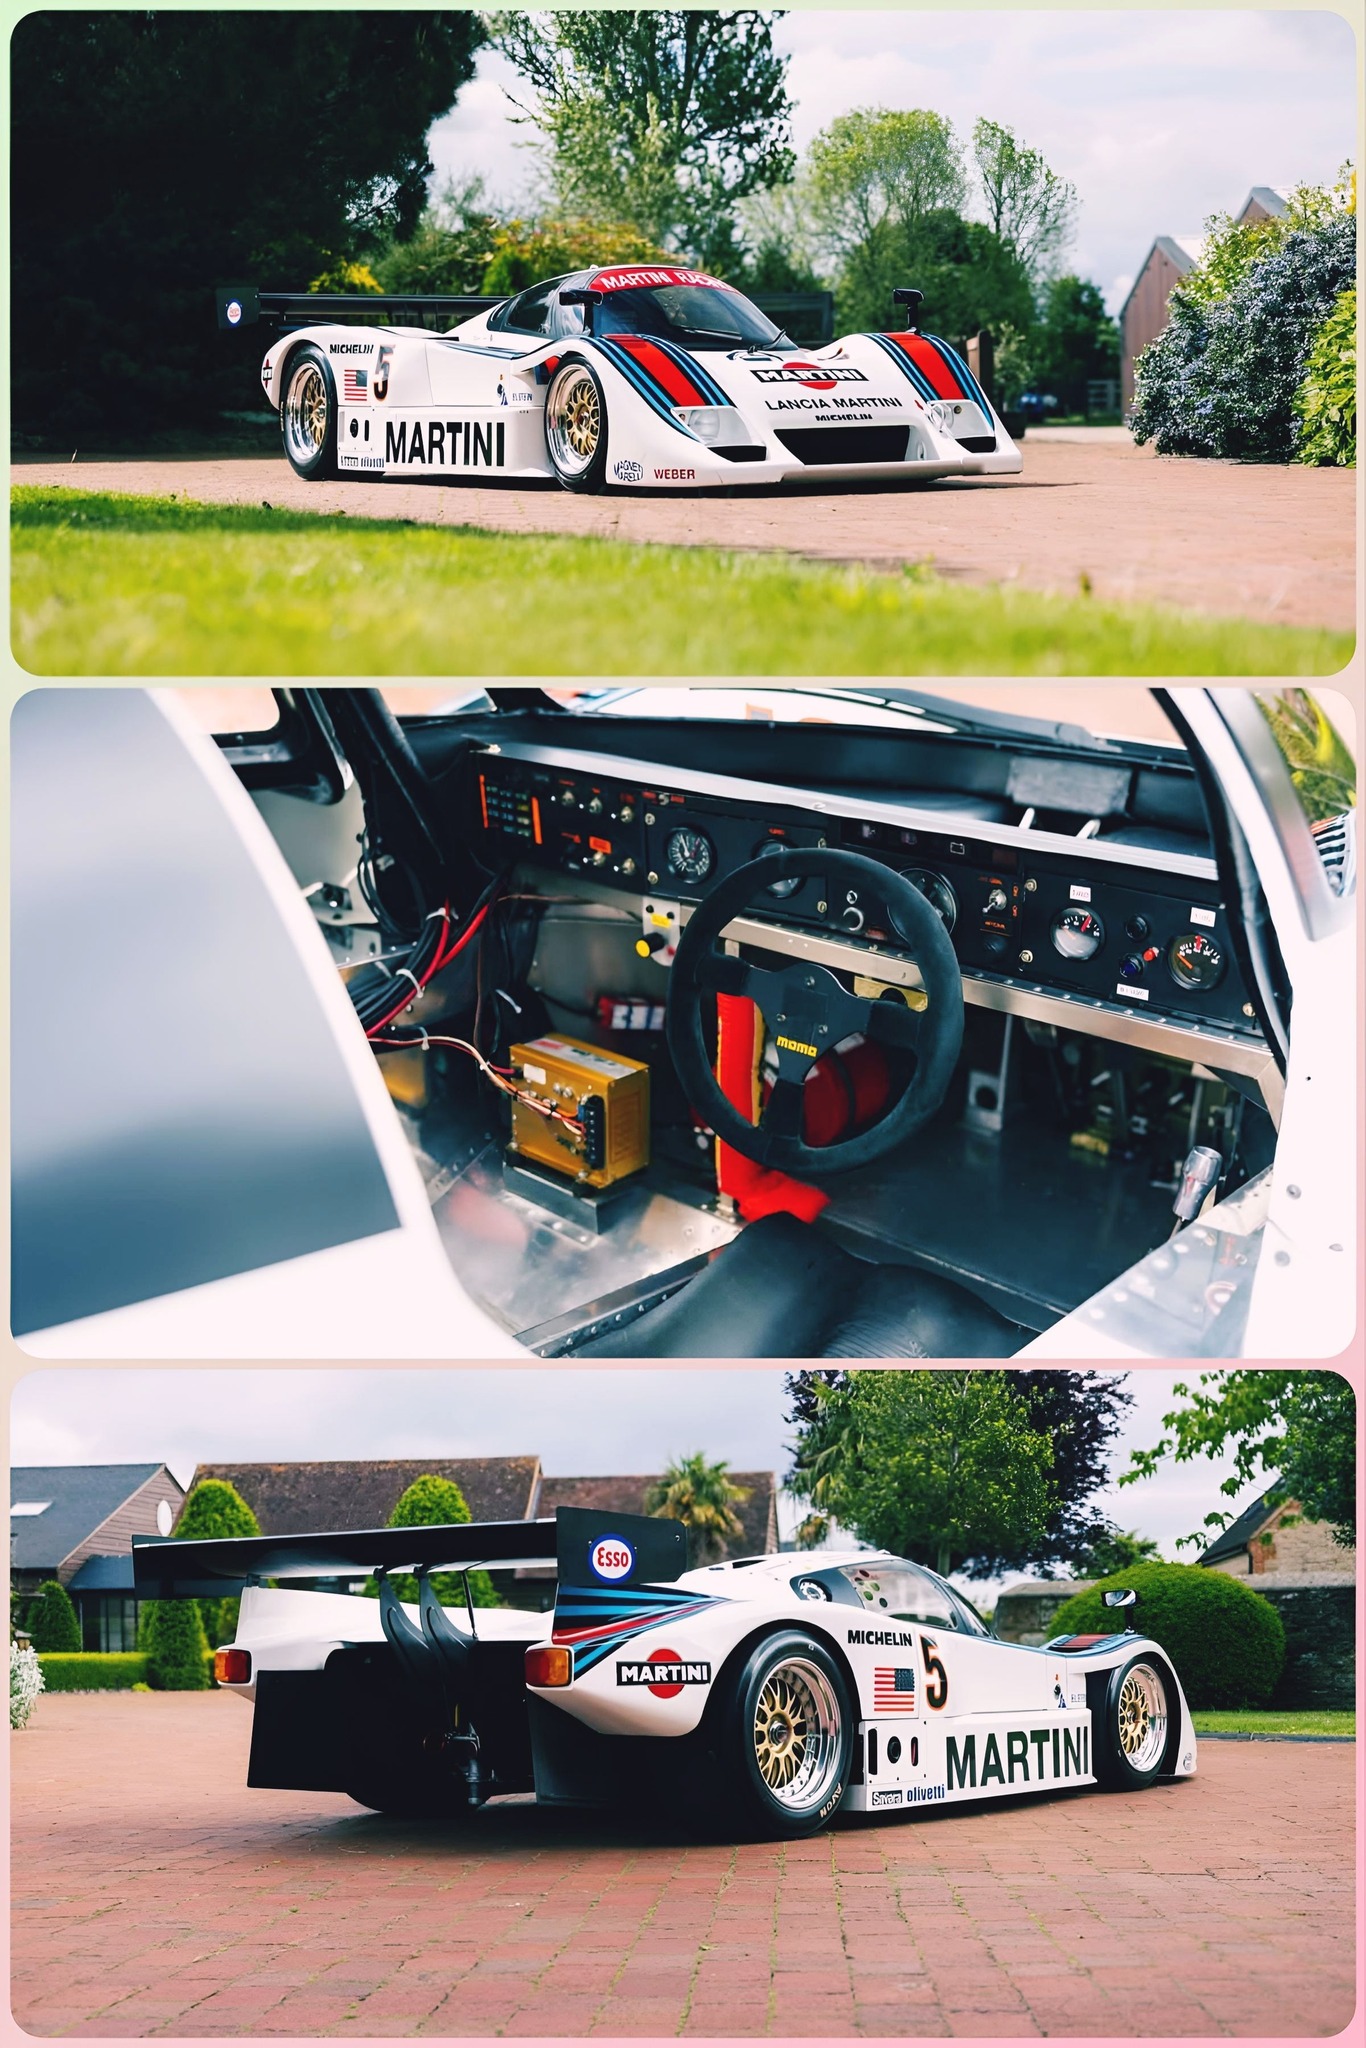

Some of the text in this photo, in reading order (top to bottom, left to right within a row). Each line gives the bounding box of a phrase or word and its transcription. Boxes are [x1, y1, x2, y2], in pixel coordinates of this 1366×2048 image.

[601, 271, 673, 289] MARTINI
[373, 344, 396, 401] 5
[756, 369, 862, 381] MARTINI
[765, 397, 903, 411] LANCIA MARTINI
[385, 421, 505, 467] MARTINI
[653, 468, 696, 480] WEBER
[847, 1629, 913, 1647] MICHELIN
[621, 1664, 708, 1682] MARTINI
[919, 1633, 948, 1711] 5
[946, 1726, 1089, 1791] MARTINI
[819, 1782, 843, 1818] AVON
[906, 1783, 945, 1802] olivetti
